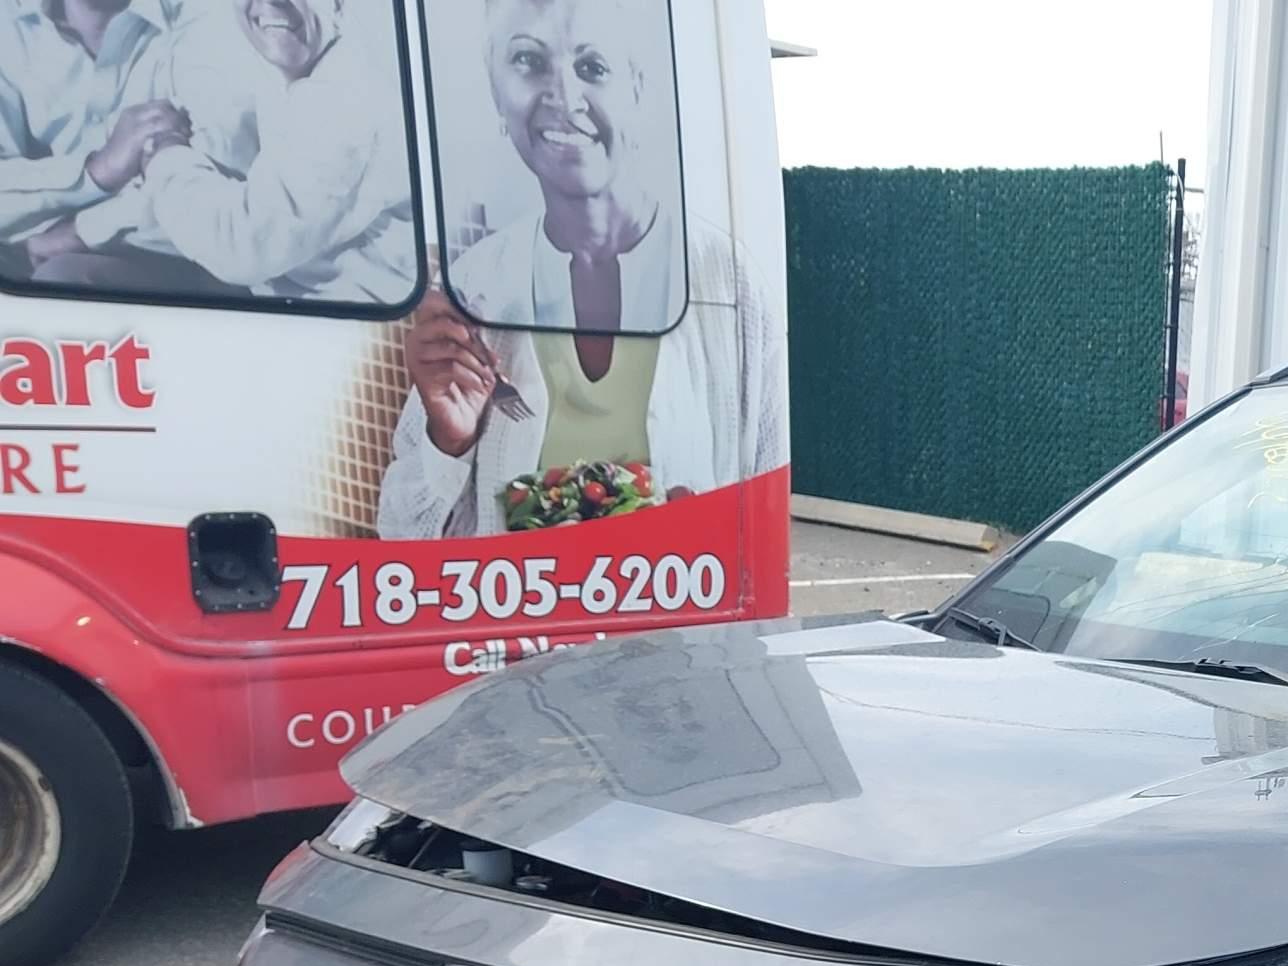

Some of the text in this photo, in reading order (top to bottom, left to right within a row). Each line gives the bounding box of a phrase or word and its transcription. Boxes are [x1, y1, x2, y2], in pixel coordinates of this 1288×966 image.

[280, 552, 727, 630] 718-305-6200
[444, 638, 507, 676] Call
[287, 704, 416, 748] COU
